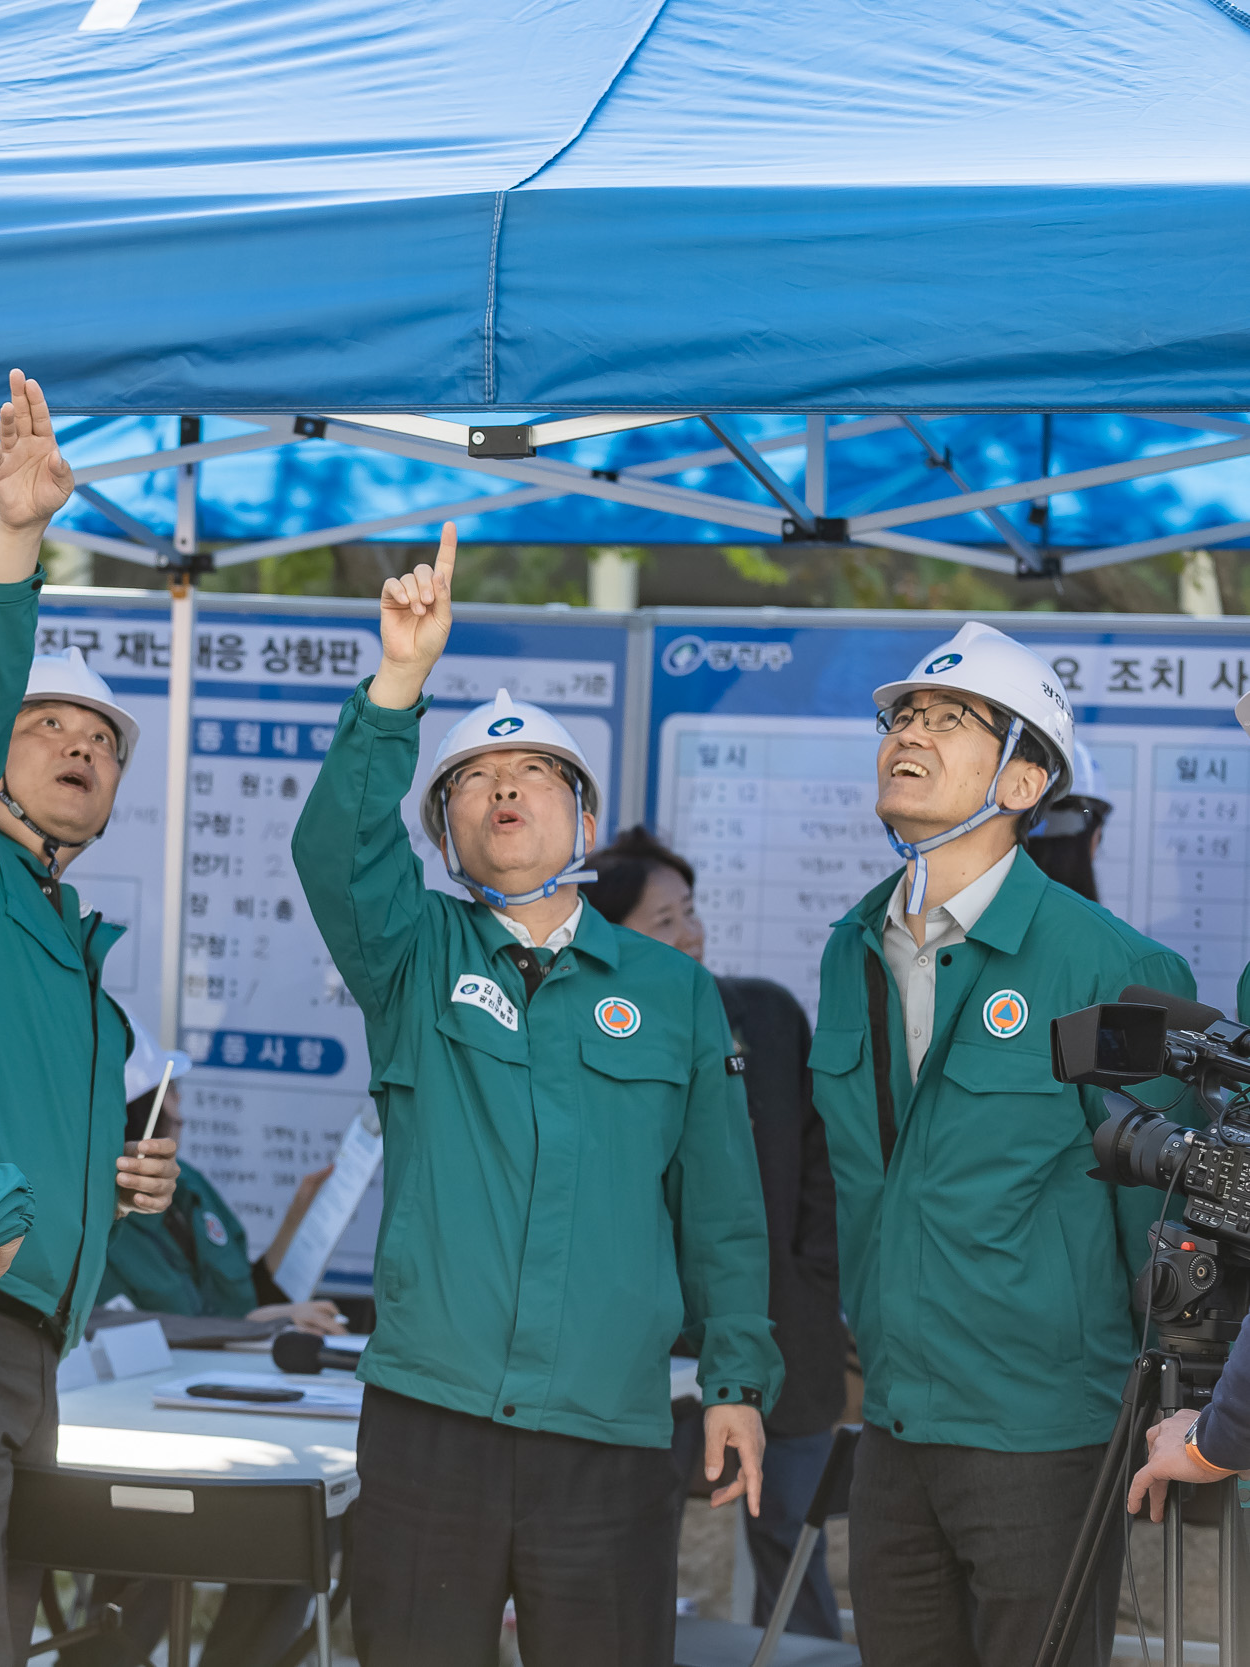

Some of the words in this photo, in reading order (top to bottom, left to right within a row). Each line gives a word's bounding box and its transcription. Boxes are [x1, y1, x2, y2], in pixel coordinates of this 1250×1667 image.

[39, 626, 103, 664] 진구
[261, 635, 360, 676] 상황판
[1052, 657, 1083, 691] 요
[1107, 657, 1185, 695] 조치
[1211, 658, 1250, 697] 사
[1176, 756, 1227, 783] 일시
